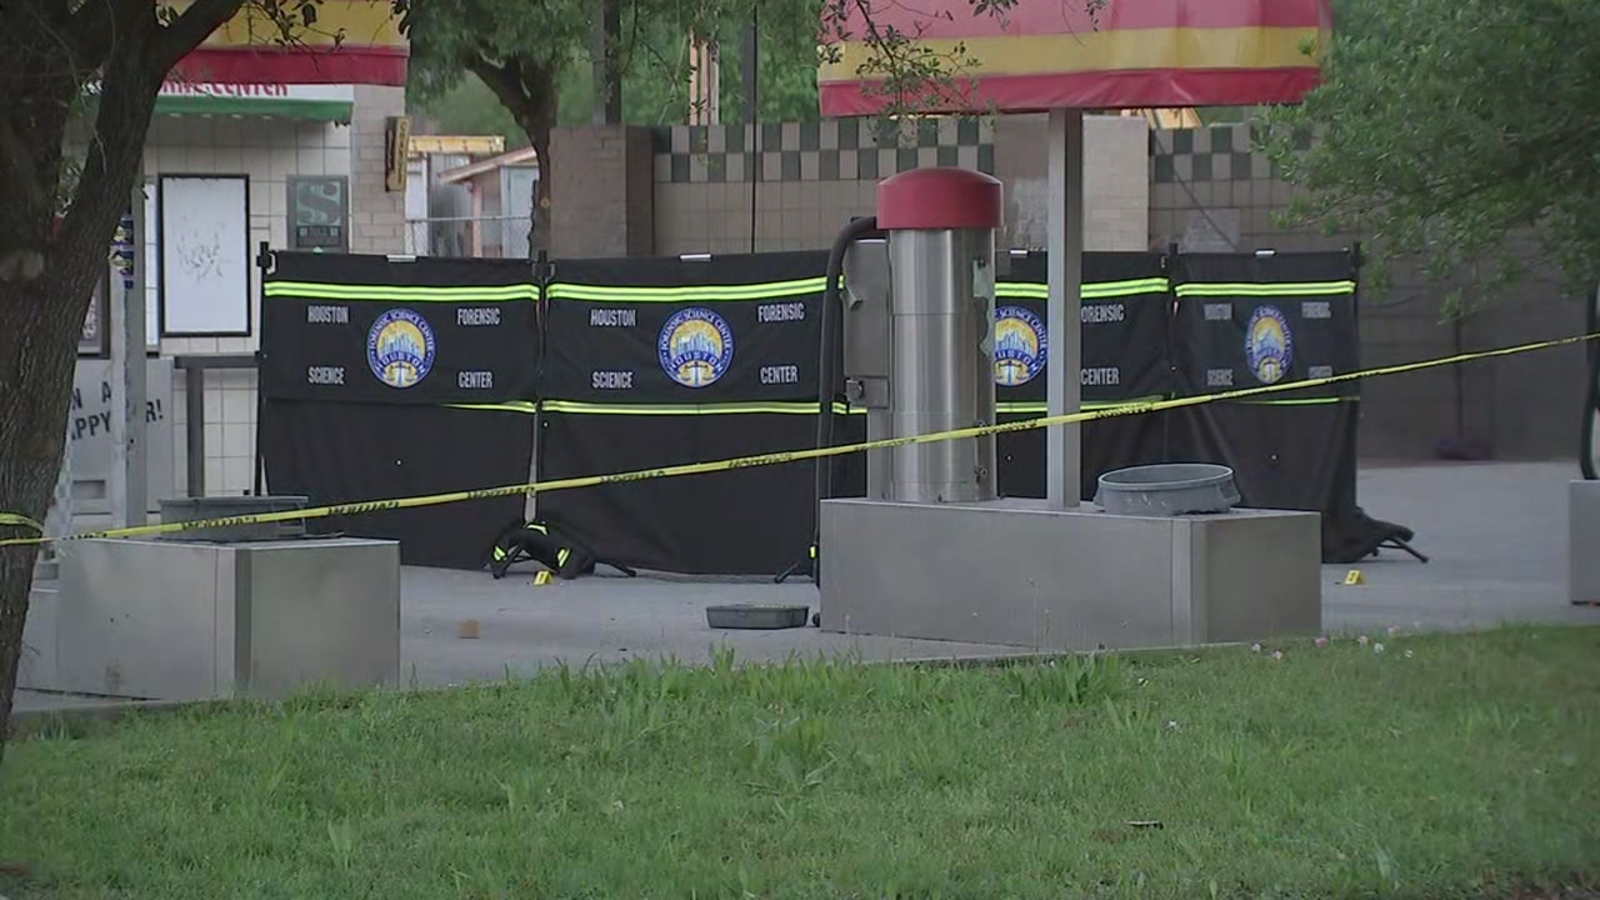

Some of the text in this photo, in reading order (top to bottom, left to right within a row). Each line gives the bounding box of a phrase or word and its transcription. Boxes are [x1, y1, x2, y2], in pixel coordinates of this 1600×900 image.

[308, 306, 501, 325] HOUSTON FORENSIC
[590, 303, 805, 326] HOUSTON FORENSIC
[1081, 303, 1125, 322] ORENSIC
[375, 351, 426, 373] HOUSTON
[669, 351, 723, 372] HOUSTON
[997, 351, 1039, 371] USTON
[308, 366, 493, 389] SCIENCE CENTER
[592, 366, 798, 388] SCIENCE CENTER
[1081, 366, 1120, 386] CENTER
